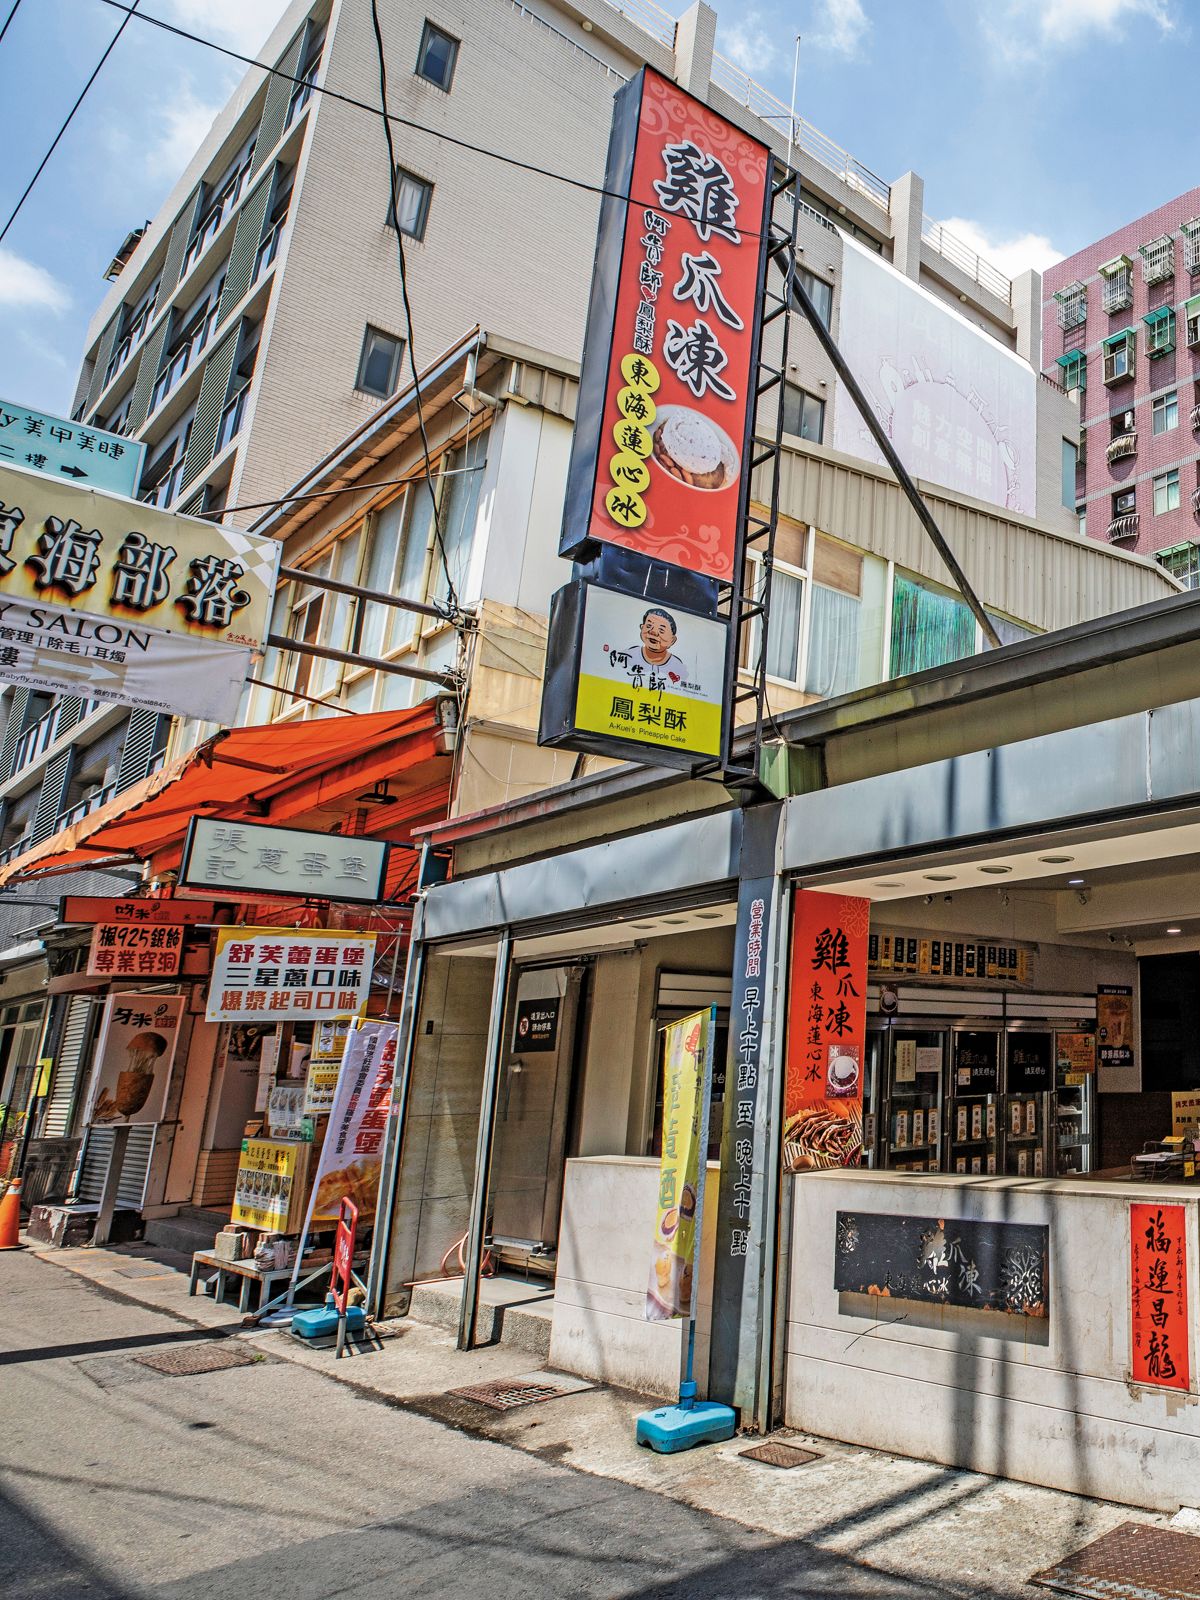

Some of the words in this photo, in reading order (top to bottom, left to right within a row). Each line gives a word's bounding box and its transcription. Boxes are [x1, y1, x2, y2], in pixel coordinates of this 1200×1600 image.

[653, 140, 745, 401] 雞爪凍
[633, 299, 656, 354] 鳳梨酥
[24, 415, 125, 461] 美甲美睫
[610, 360, 653, 523] 東海蓮心冰
[26, 609, 156, 652] SALON
[47, 637, 81, 654] 除毛
[609, 696, 687, 731] 鳳梨酥
[609, 722, 636, 734] A-Kuei's
[639, 727, 669, 740] Pineapple
[670, 734, 686, 744] Cake
[204, 826, 249, 881] 張記
[227, 943, 365, 966] 舒芙蕾蛋堡
[745, 900, 765, 978] 營業時間
[220, 990, 359, 1011] 爆漿起司口味
[811, 927, 860, 1038] 雞爪凍
[737, 987, 760, 1092] 早上十點
[804, 981, 825, 1083] 東海蓮心冰
[736, 1101, 753, 1128] 至
[731, 1140, 753, 1256] 晚上十點
[1144, 1210, 1177, 1379] 福運昌龍
